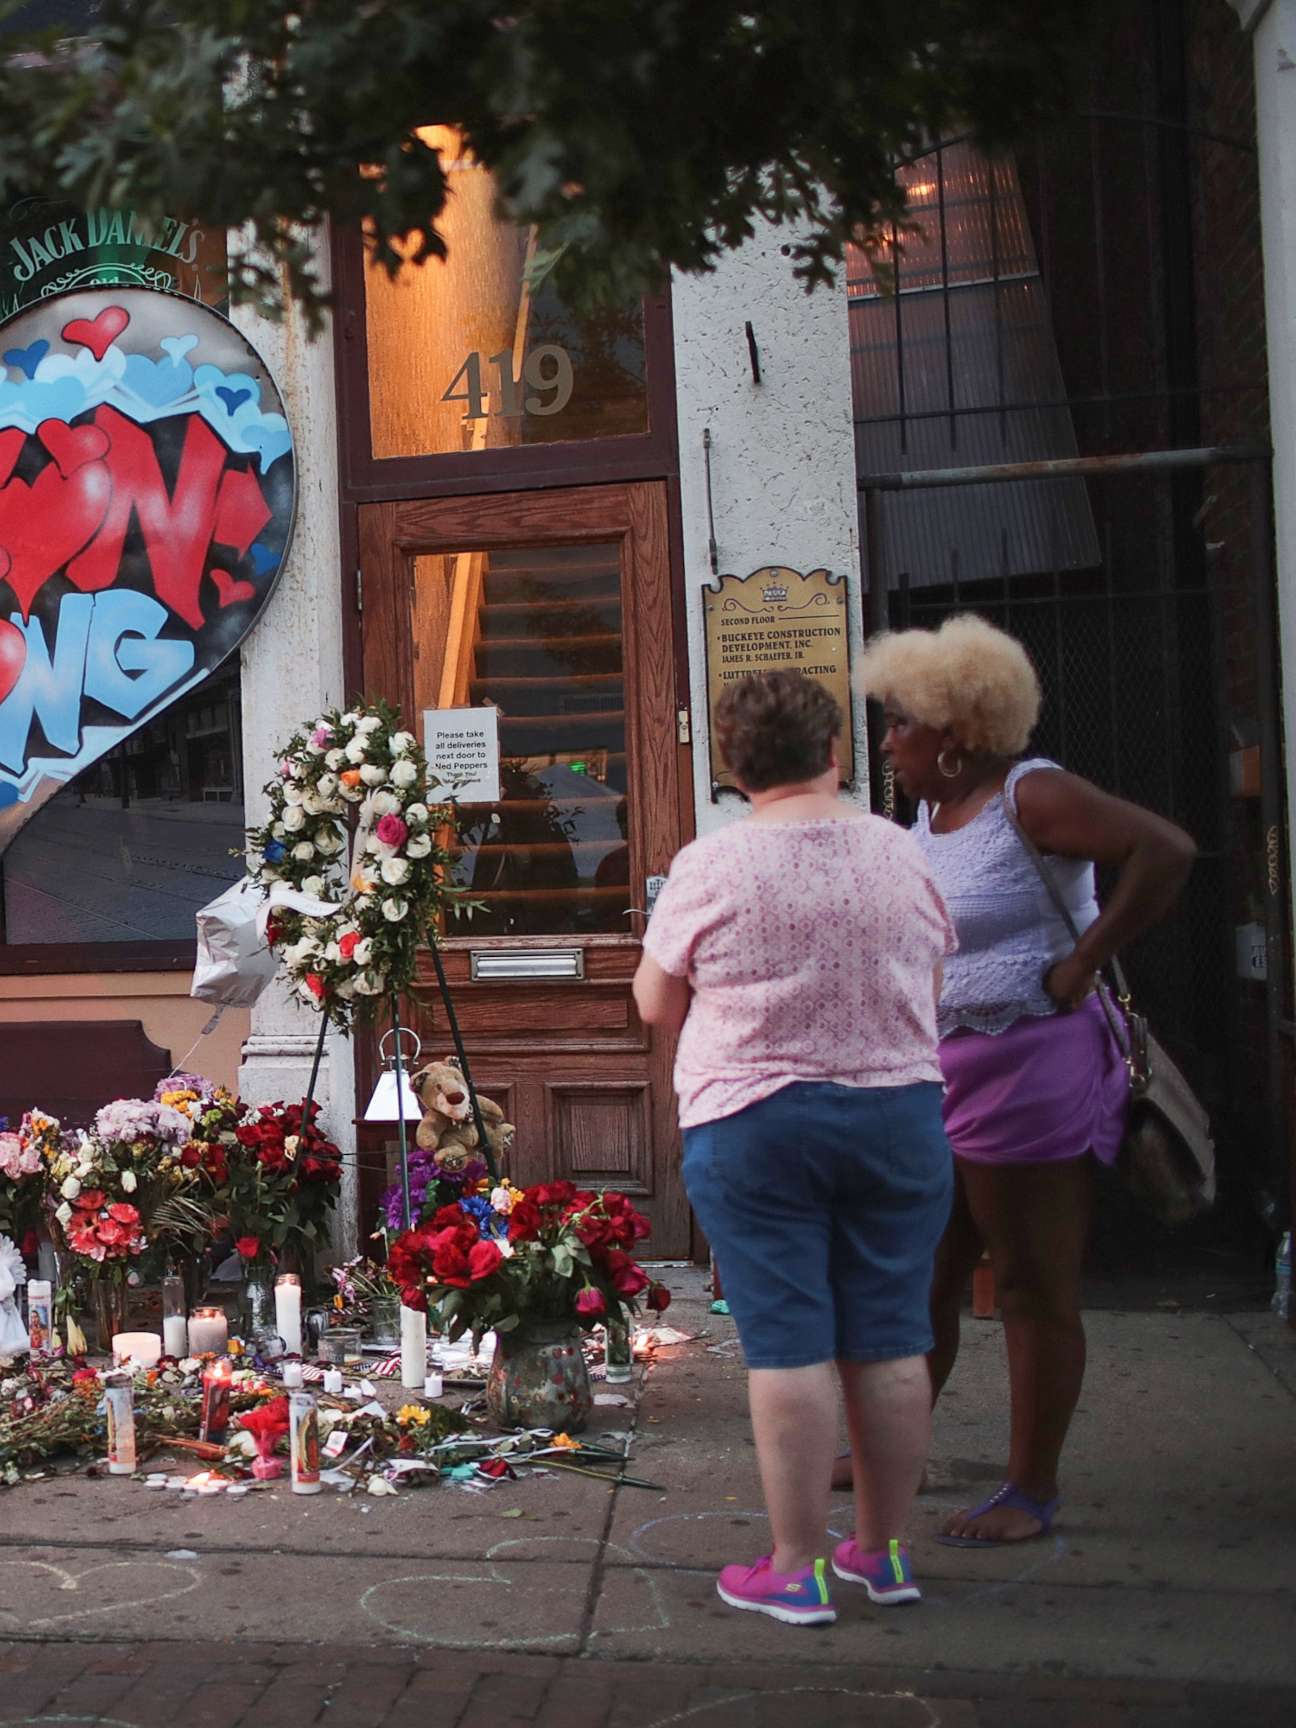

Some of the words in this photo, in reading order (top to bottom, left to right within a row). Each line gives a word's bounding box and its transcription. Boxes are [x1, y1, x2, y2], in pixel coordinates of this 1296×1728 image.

[9, 217, 86, 282] JACK
[440, 344, 574, 420] 419
[721, 617, 750, 626] SECOND
[751, 615, 775, 625] FLOOR
[722, 632, 764, 642] BUCKEYE
[767, 628, 841, 639] CONSTRUCTION
[722, 653, 744, 664] JAMES
[436, 731, 464, 739] Please
[466, 730, 484, 738] take
[447, 741, 486, 749] deliveries
[435, 762, 452, 770] Ned
[454, 762, 488, 770] Peppers
